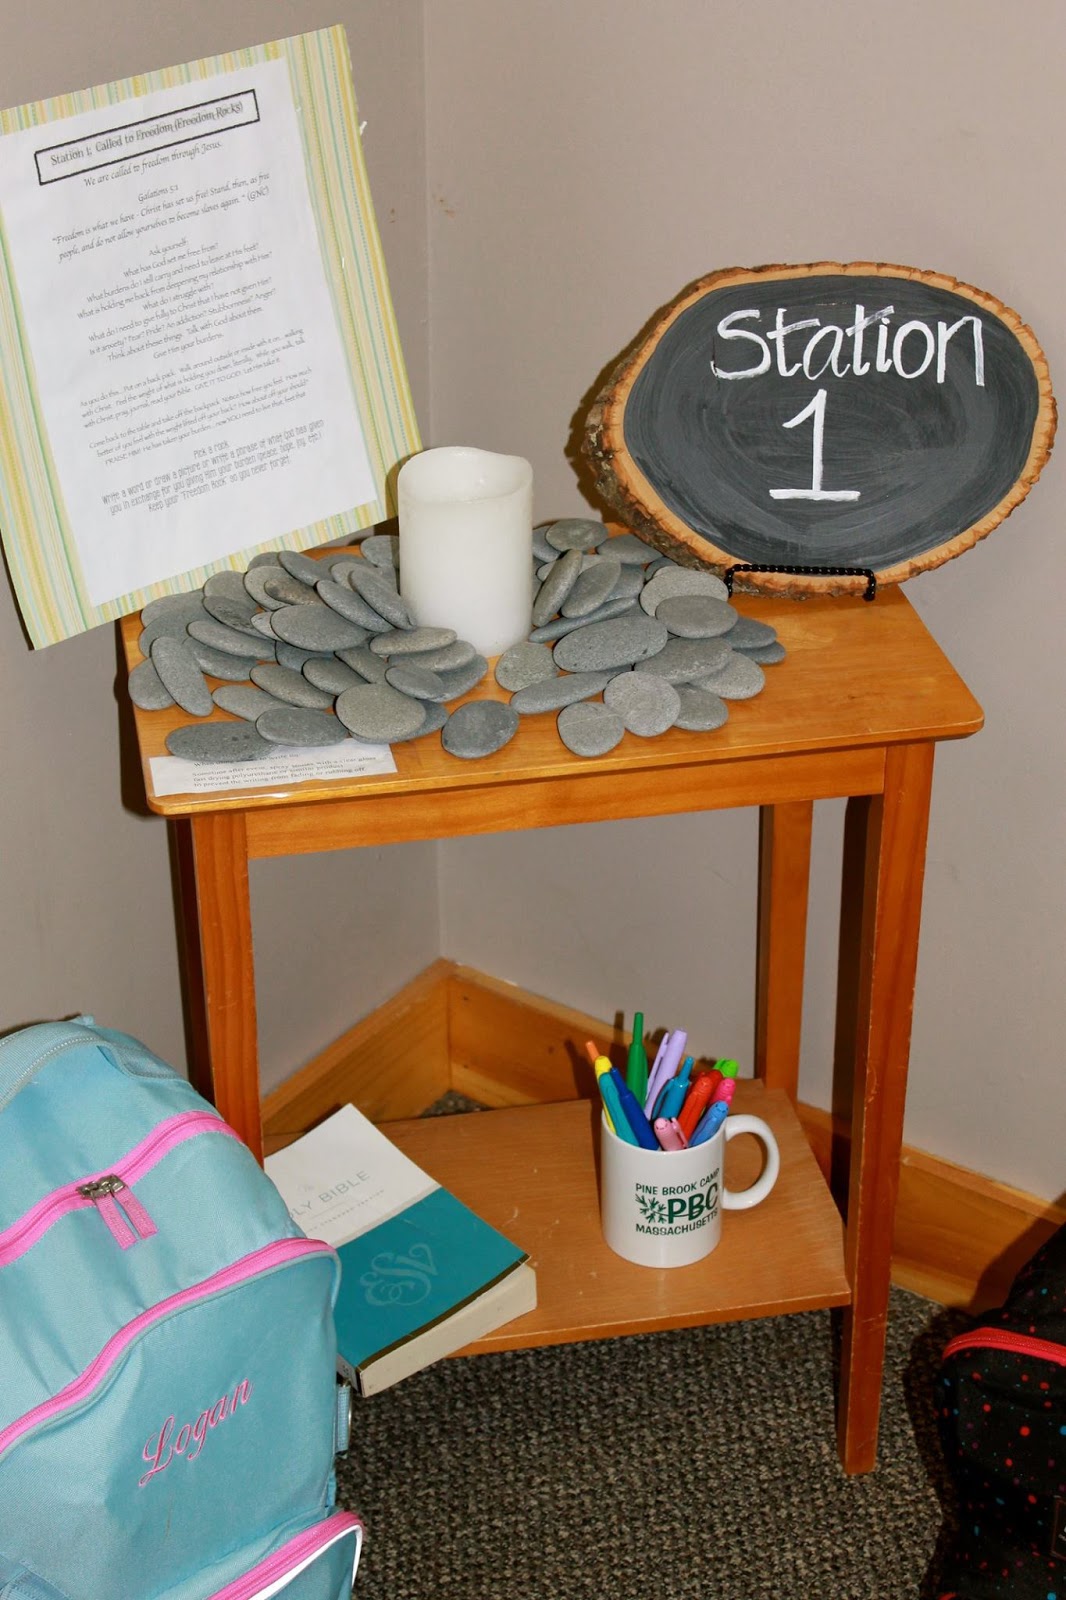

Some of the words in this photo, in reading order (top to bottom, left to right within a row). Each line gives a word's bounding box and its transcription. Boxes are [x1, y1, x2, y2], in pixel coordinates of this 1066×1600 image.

[51, 150, 84, 165] Station
[96, 136, 122, 152] Called
[125, 135, 134, 144] to
[136, 124, 173, 140] Freedom
[710, 304, 985, 387] Station
[769, 388, 861, 501] 1
[318, 1170, 370, 1203] BIBLE
[635, 1183, 658, 1195] PINE
[662, 1182, 697, 1196] BROOK
[667, 1182, 718, 1224] PBC
[635, 1207, 718, 1235] MASSACHUSETTS
[138, 1378, 253, 1487] Logan
